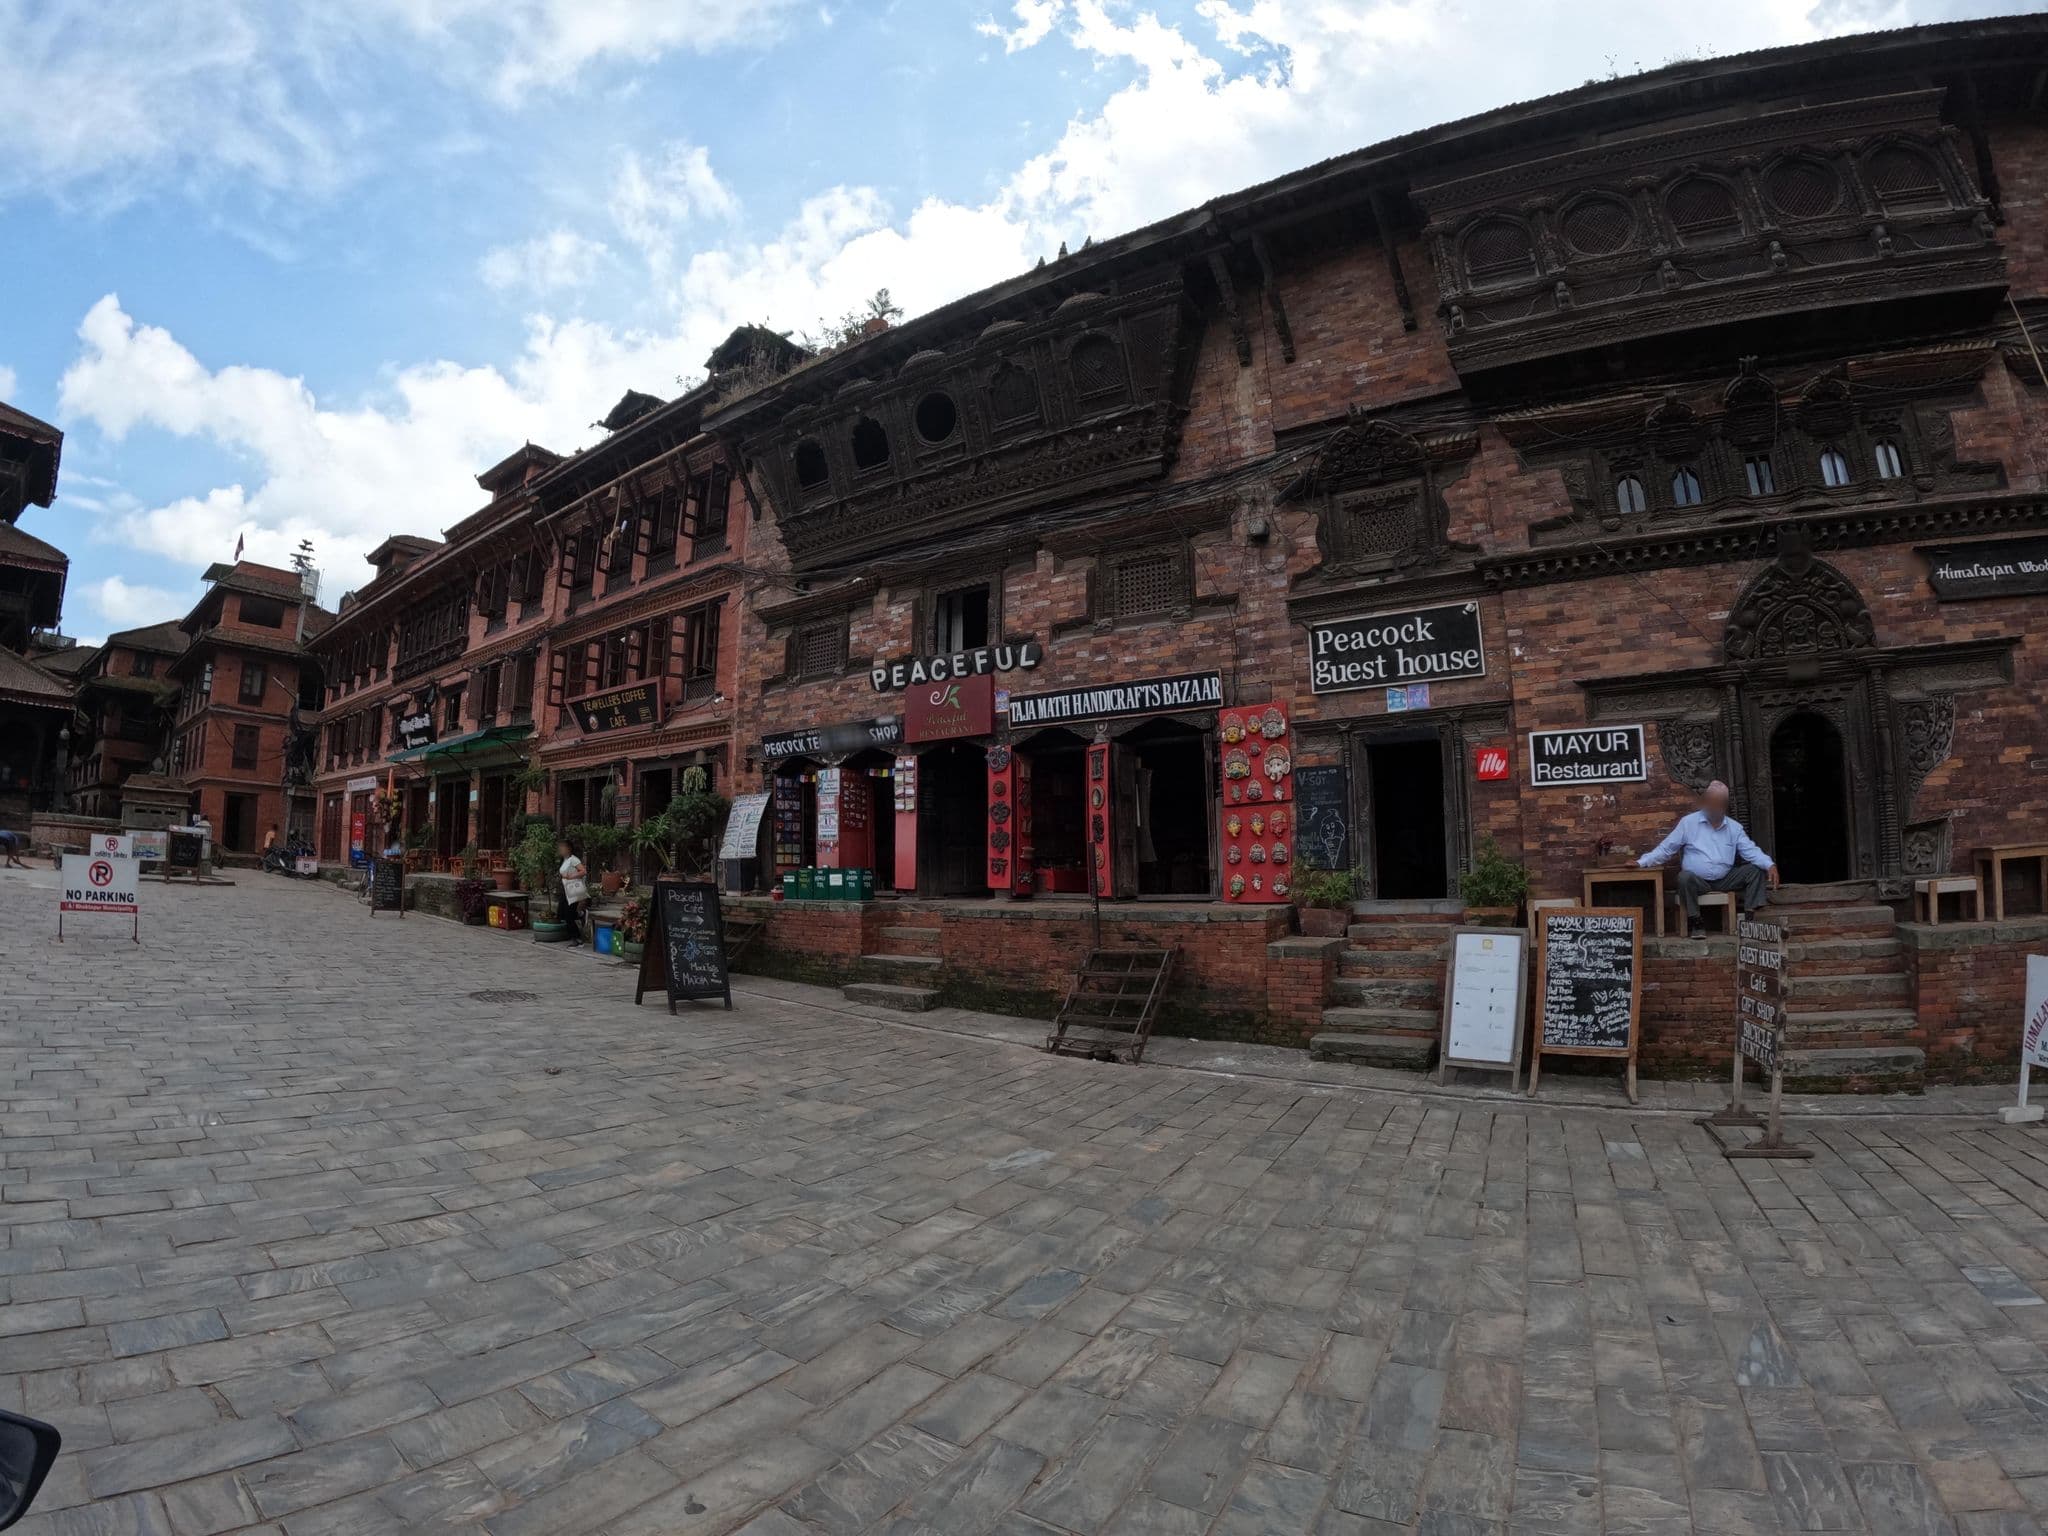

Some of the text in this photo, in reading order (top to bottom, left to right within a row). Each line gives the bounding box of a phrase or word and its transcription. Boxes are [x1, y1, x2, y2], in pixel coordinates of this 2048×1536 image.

[1936, 563, 2016, 581] Himalayan
[1316, 617, 1435, 655] Peacock
[872, 644, 1035, 691] PEACEFUL
[1315, 655, 1388, 686] guest
[1395, 648, 1480, 677] house
[622, 688, 647, 704] COFFEE
[1010, 677, 1221, 723] TAJA MATH HANDICRAFTS BAZAAR
[764, 738, 806, 757] PEACOCK
[869, 724, 899, 742] SHOP
[1544, 732, 1629, 756] MAYUR
[1480, 752, 1506, 776] illy
[1537, 758, 1640, 781] Restaurant
[66, 889, 134, 903] NO PARKING
[1740, 922, 1780, 943] SHOWROOM
[1740, 946, 1759, 965] GUEST
[1757, 1002, 1775, 1023] SHOP
[1743, 1021, 1773, 1050] BICYCLE
[1740, 1036, 1775, 1067] RENTALS
